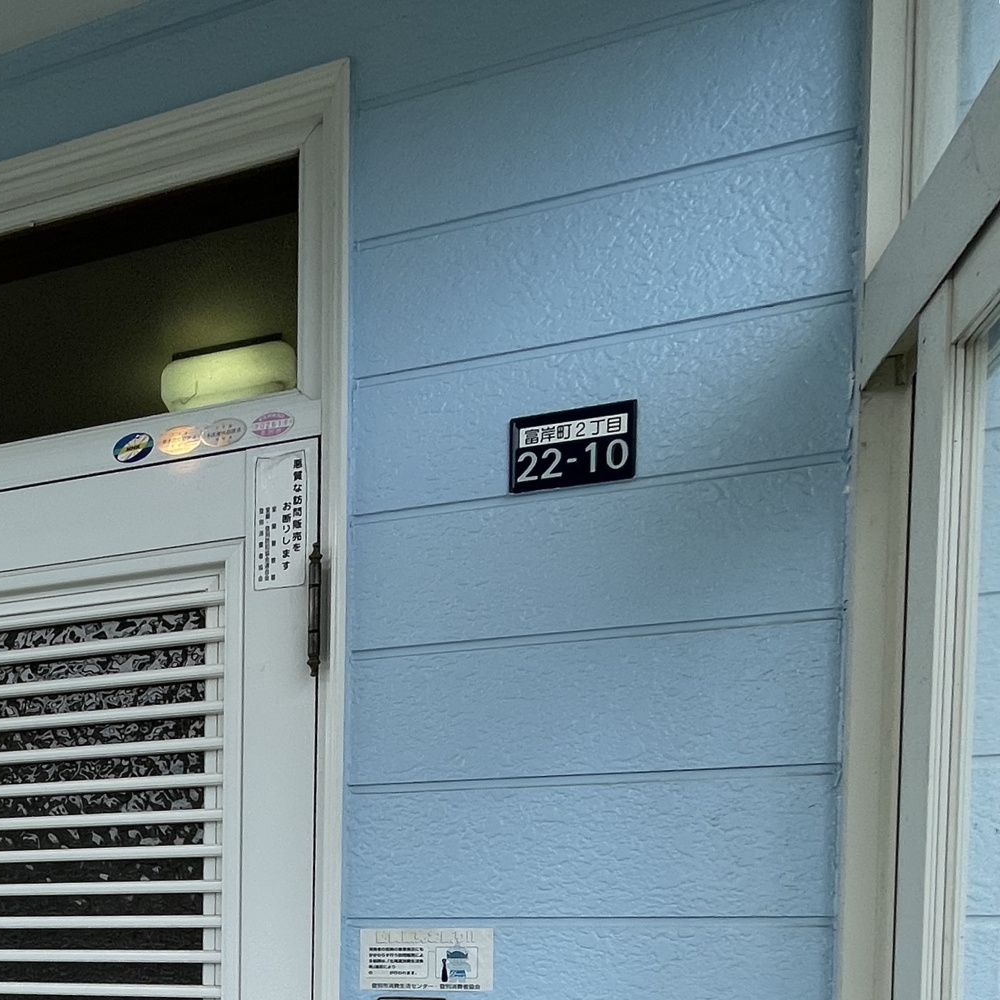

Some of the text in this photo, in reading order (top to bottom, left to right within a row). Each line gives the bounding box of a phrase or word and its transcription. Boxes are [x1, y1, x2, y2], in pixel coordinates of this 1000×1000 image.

[516, 438, 629, 483] 22-10
[281, 501, 292, 571] お断りします
